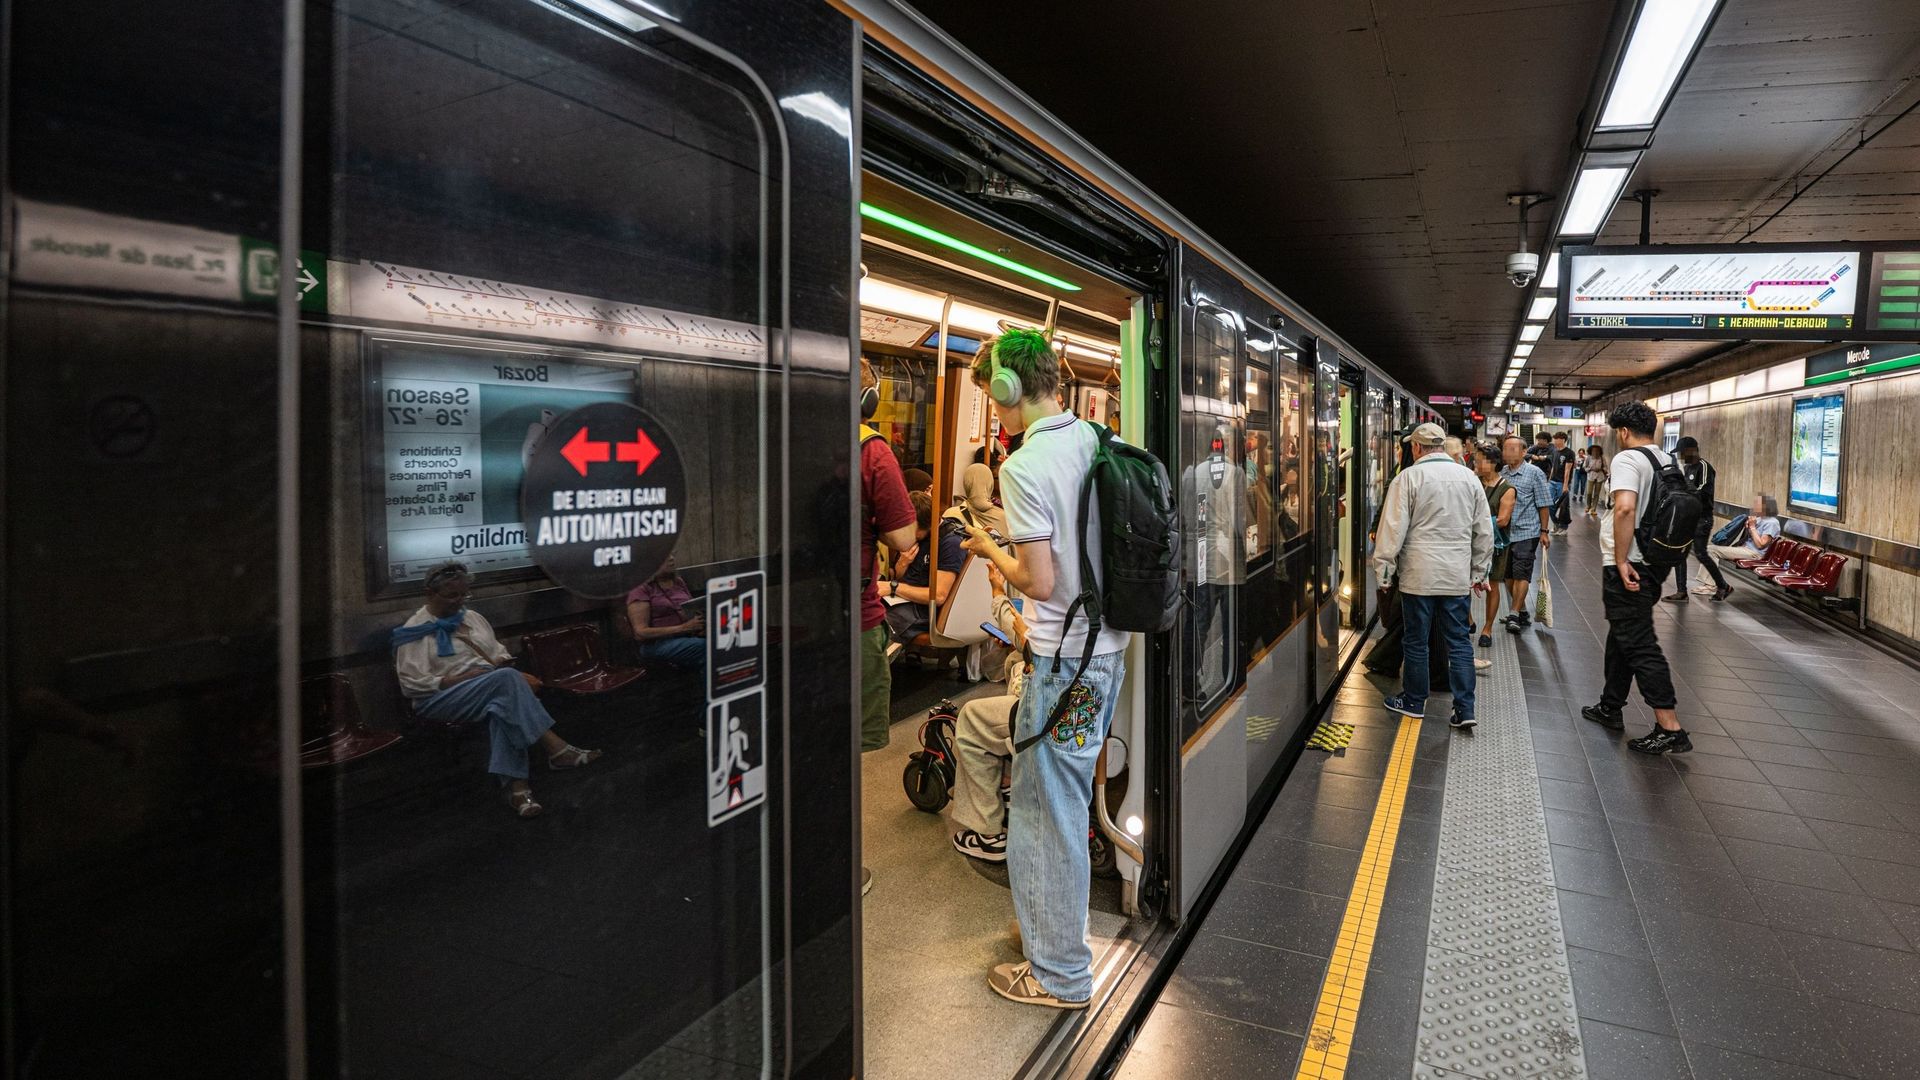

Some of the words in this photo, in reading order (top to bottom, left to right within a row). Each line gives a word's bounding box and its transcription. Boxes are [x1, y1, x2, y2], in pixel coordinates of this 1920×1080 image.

[1579, 317, 1585, 326] 1
[1590, 316, 1629, 327] STOKKEL
[1718, 317, 1725, 327] 5
[1730, 317, 1828, 328] HERRMANN-DEBROUX
[1845, 318, 1852, 328] 3
[1846, 346, 1870, 364] Merode
[552, 490, 574, 511] DE
[576, 488, 631, 509] DEUREN
[633, 487, 667, 506] GAAN
[536, 508, 677, 546] AUTOMATISCH
[593, 545, 631, 567] OPEN
